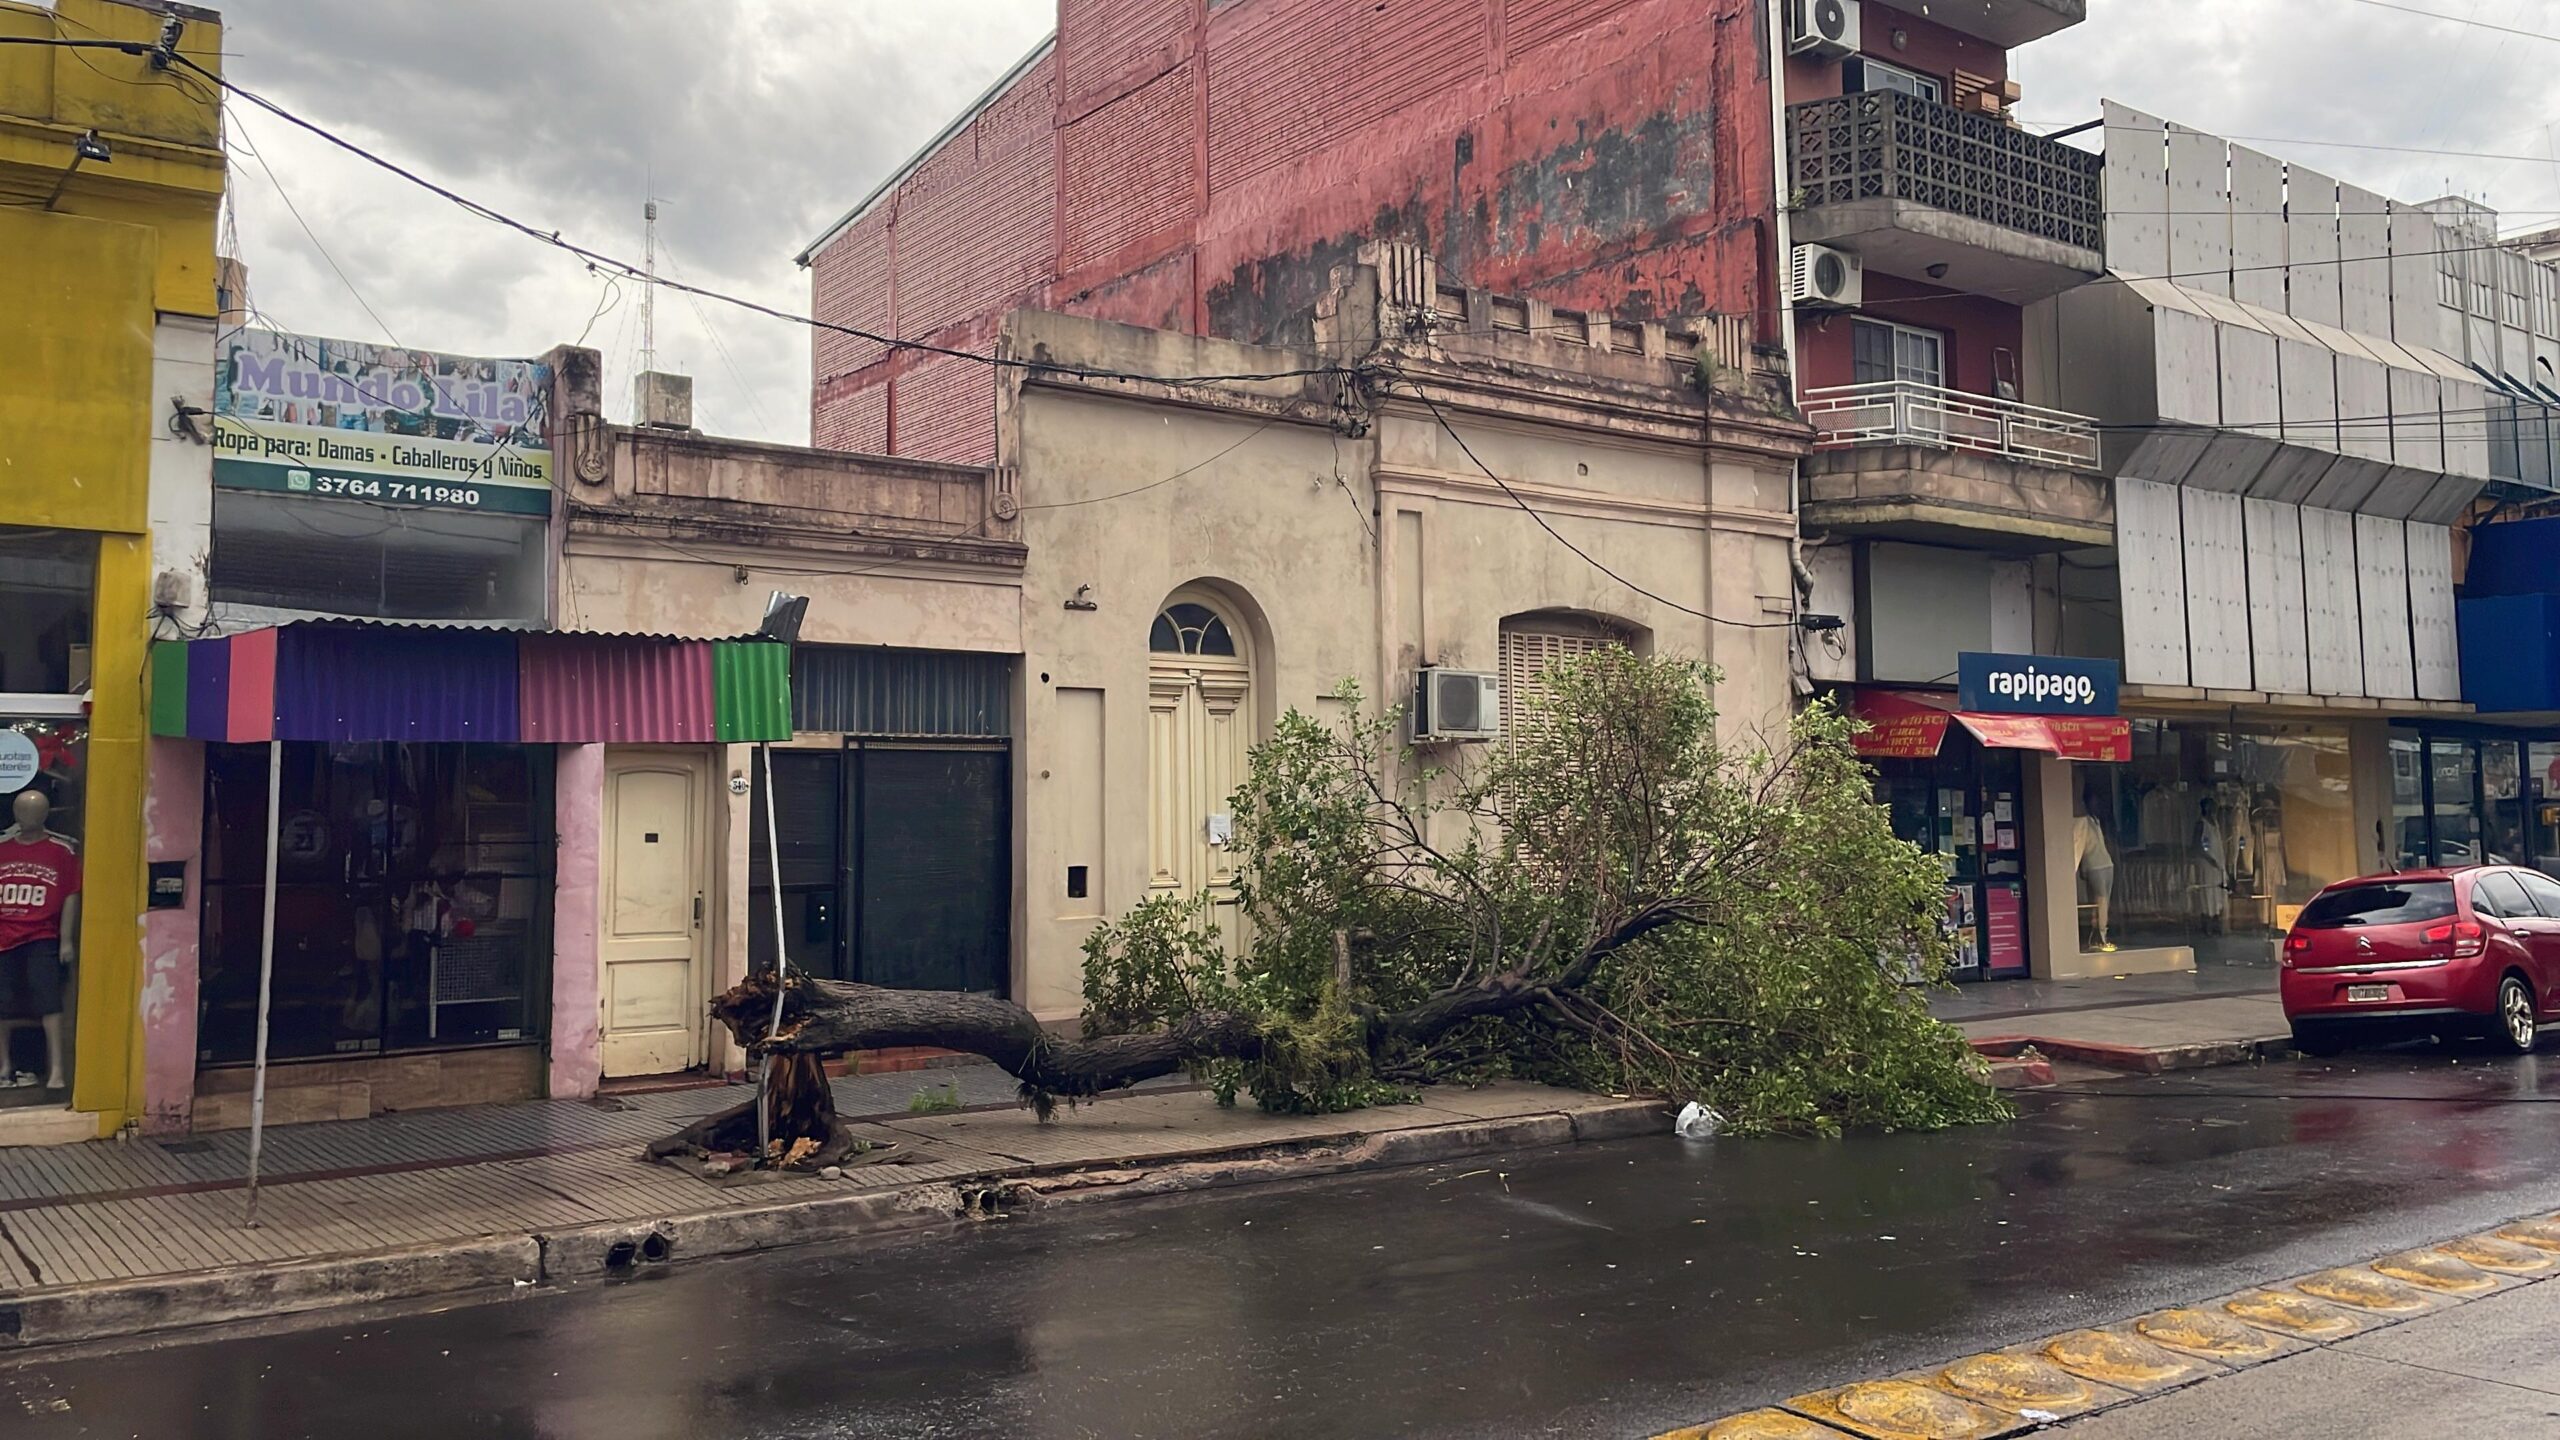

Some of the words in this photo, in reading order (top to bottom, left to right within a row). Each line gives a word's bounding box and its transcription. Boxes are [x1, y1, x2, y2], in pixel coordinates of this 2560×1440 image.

[236, 352, 423, 409] Mundo
[434, 377, 527, 423] Lila
[214, 427, 259, 454] Ropa
[264, 437, 312, 458] para:
[318, 438, 374, 463] Damas
[392, 446, 478, 473] Caballeros
[484, 461, 493, 479] y
[499, 456, 542, 479] Niños
[317, 476, 381, 497] 3764
[388, 483, 480, 505] 711980
[0, 883, 47, 906] 008
